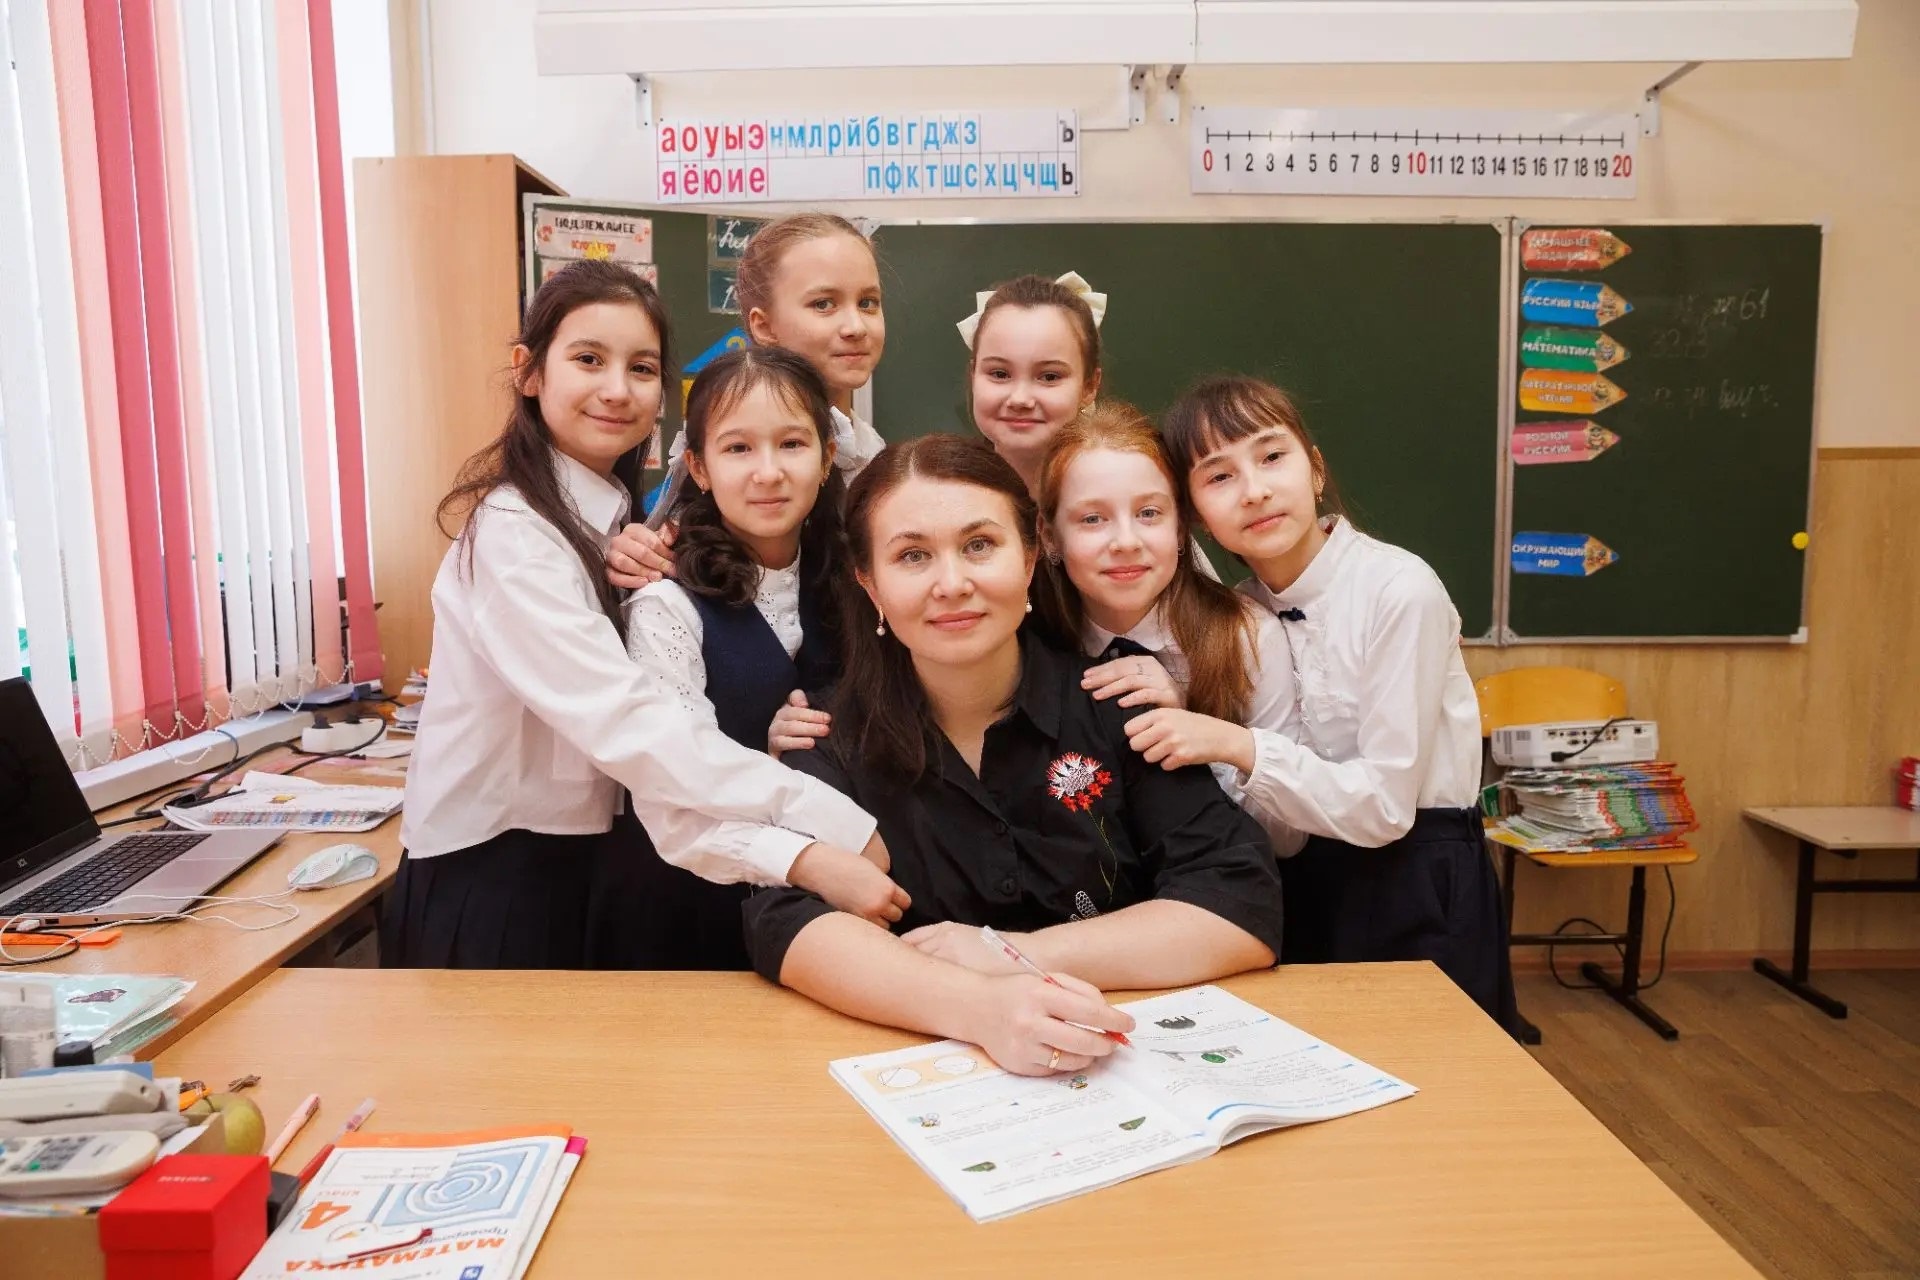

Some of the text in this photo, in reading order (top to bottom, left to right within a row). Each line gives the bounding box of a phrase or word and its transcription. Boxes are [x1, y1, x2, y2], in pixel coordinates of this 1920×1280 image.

[1203, 149, 1632, 178] 0 1 2 3 4 5 6 7 8 9 10 11 12 13 14 15 16 17 18 19 20
[1522, 295, 1572, 307] РУССКИЙ
[1522, 341, 1598, 357] МАТЕМАТИКА
[1523, 445, 1572, 455] РУССКИЙ
[1537, 558, 1561, 569] МИР
[300, 1201, 352, 1230] 4
